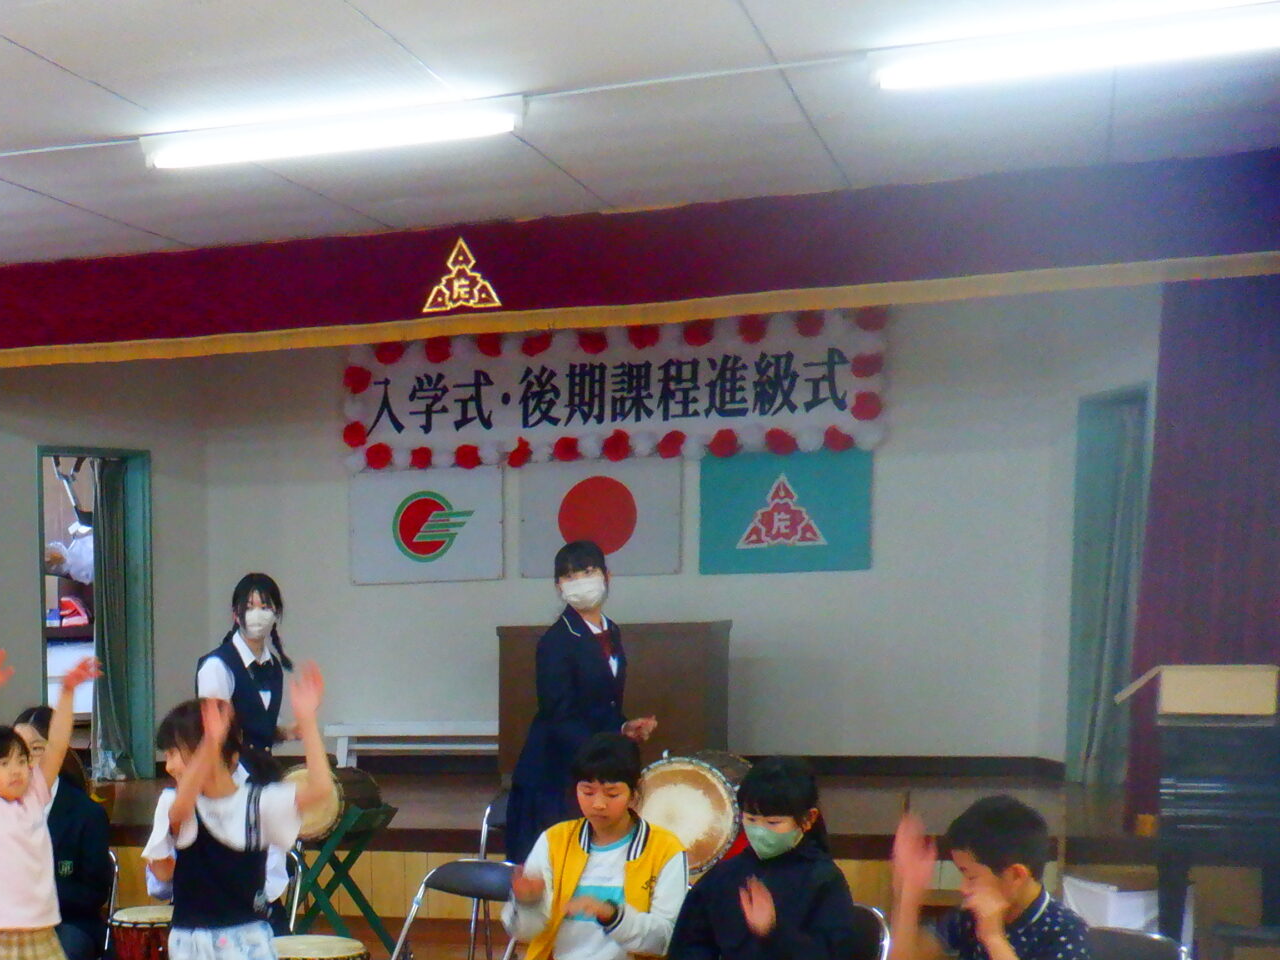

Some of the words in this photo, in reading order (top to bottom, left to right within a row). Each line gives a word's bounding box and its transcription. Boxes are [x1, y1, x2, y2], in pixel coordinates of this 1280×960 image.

[366, 348, 850, 437] 入学式・後期課程進級式
